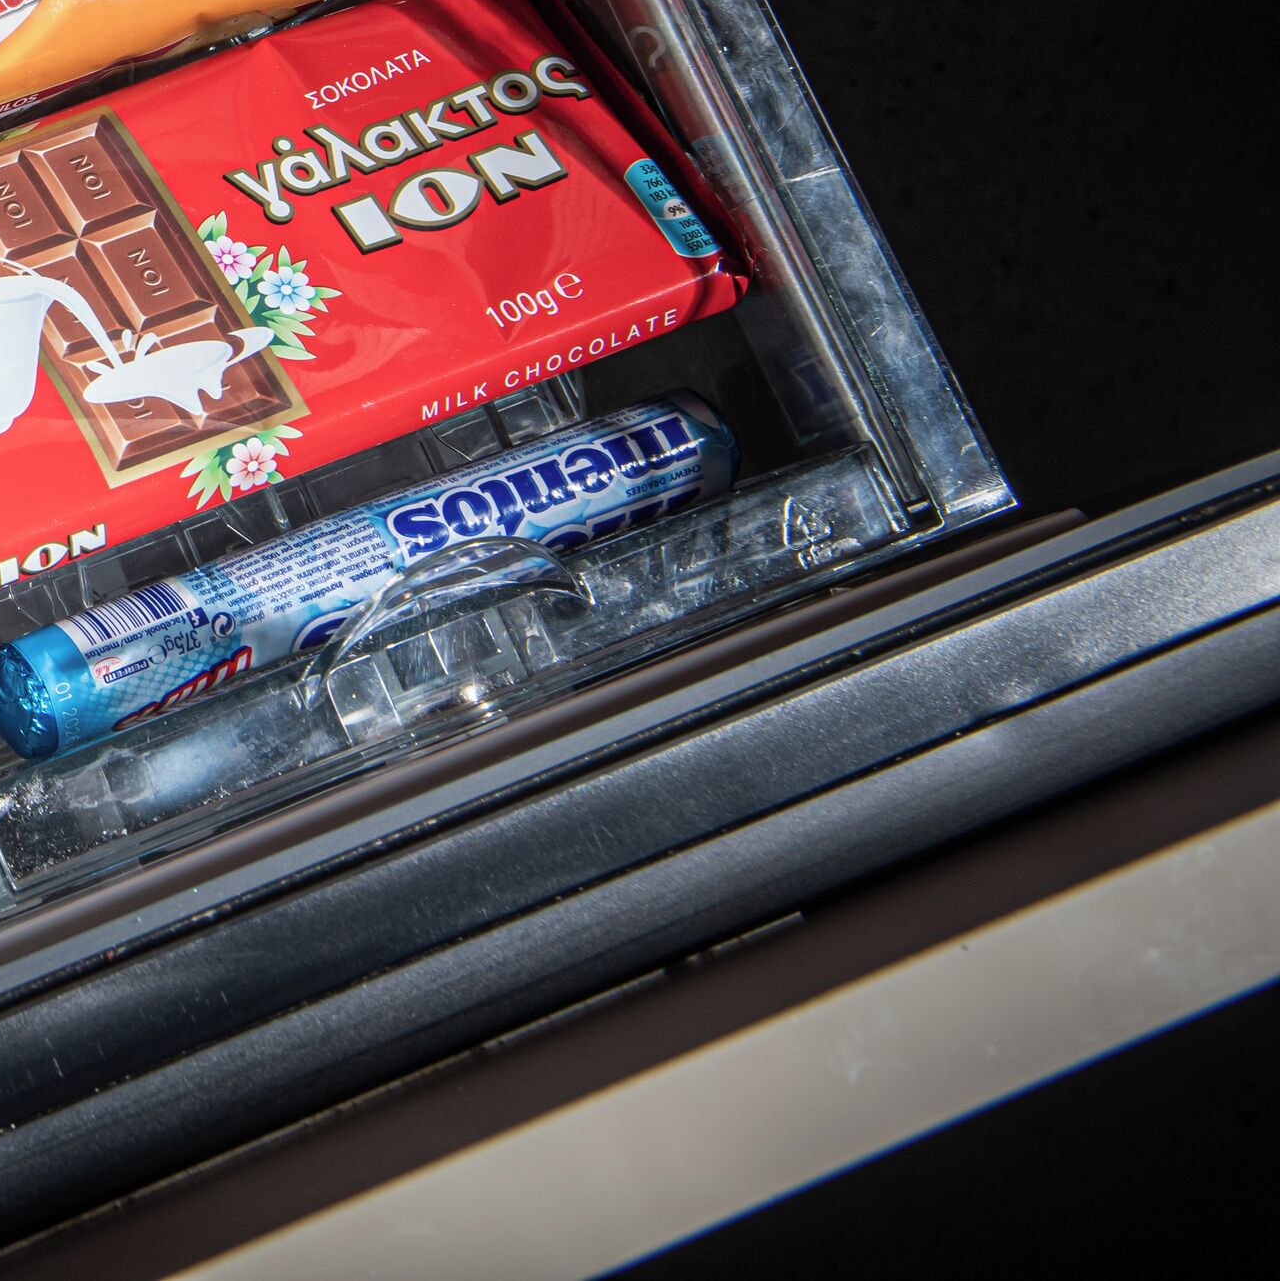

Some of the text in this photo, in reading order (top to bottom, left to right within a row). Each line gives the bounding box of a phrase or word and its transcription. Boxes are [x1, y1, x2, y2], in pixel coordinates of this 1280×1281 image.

[303, 47, 432, 110] ΣΟΚΟΛΑΤΑ
[638, 160, 660, 178] 33g
[643, 175, 664, 191] 766
[333, 131, 569, 254] ION
[648, 188, 668, 204] 183
[685, 238, 704, 253] 550
[485, 285, 559, 332] 100g
[421, 307, 679, 421] MILK CHOCOLATE
[390, 416, 696, 558] mentos
[623, 462, 702, 498] CHEWY DRAGEES
[84, 614, 186, 660] facebook.com/mentos
[164, 628, 202, 656] 37,5g
